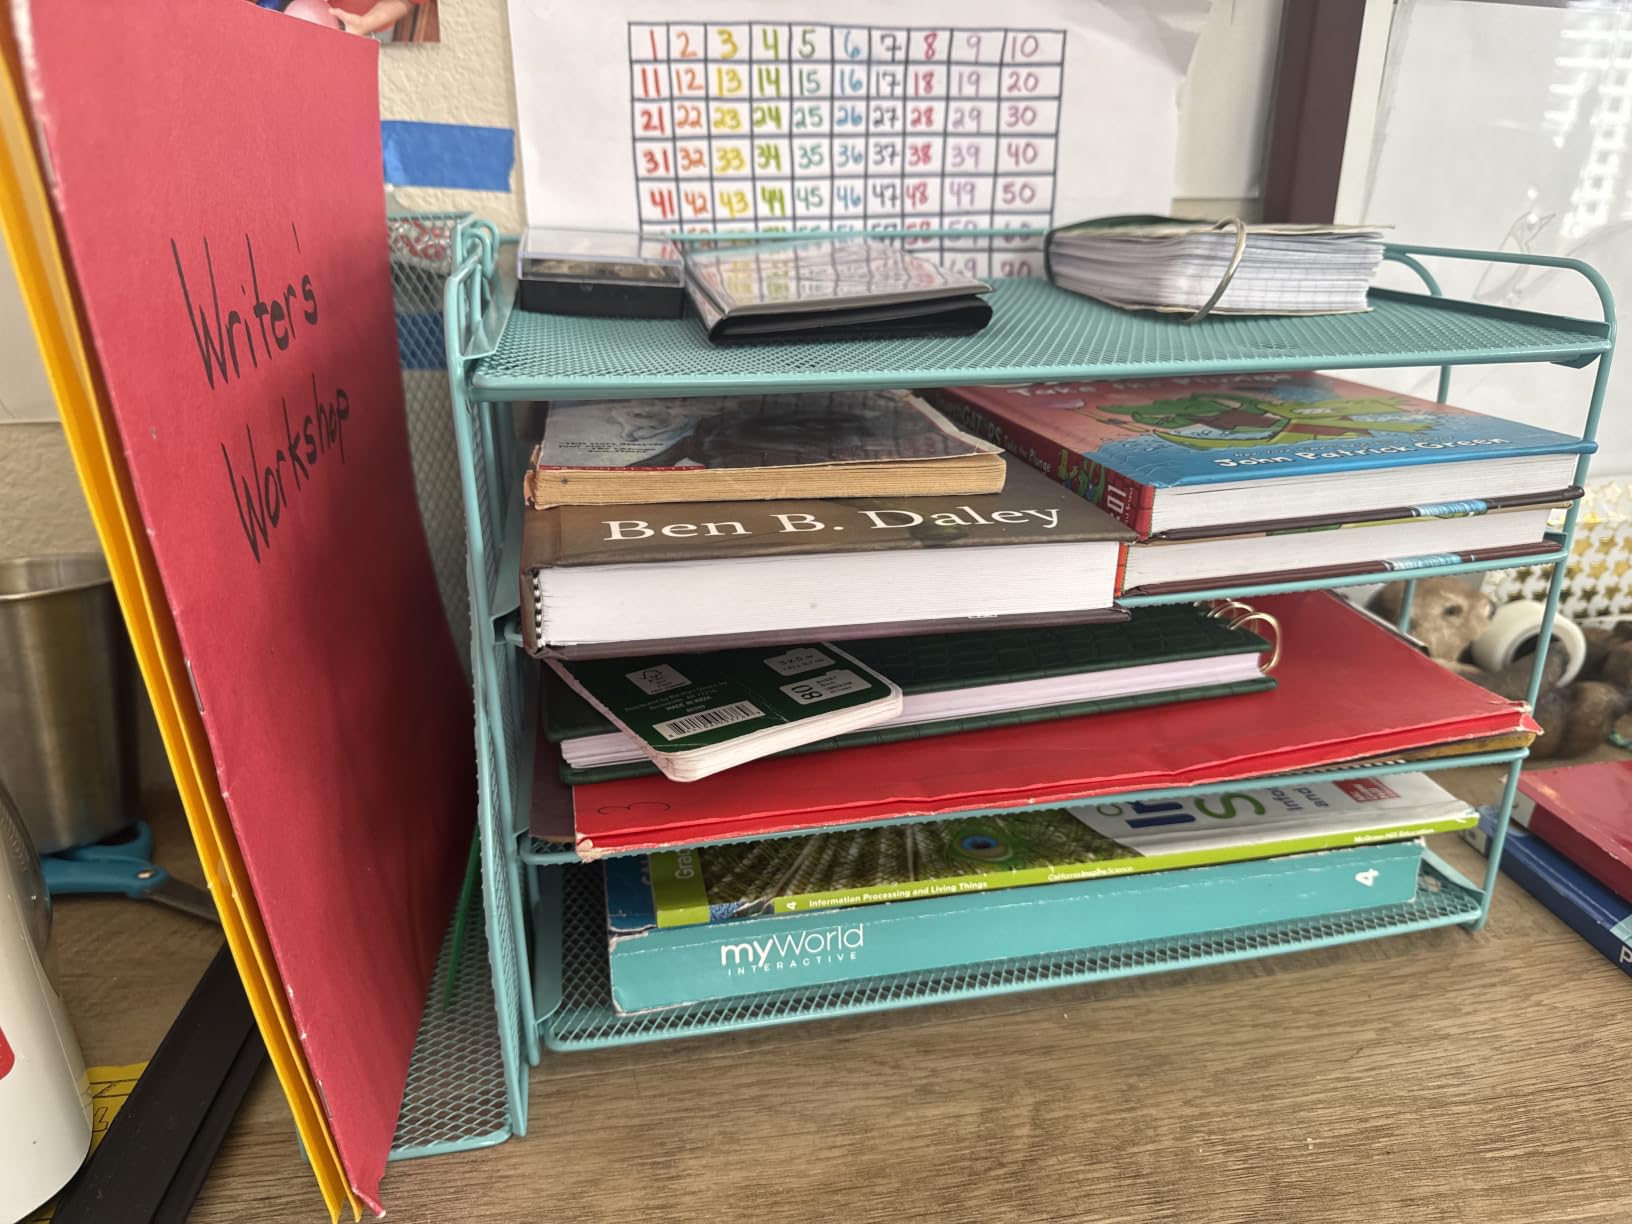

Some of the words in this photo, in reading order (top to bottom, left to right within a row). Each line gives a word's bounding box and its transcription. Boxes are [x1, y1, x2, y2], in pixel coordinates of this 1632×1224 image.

[650, 29, 658, 61] 1
[676, 31, 697, 57] 2
[717, 29, 737, 59] 3
[762, 28, 778, 60] 4
[799, 28, 816, 59] 5
[844, 31, 860, 58] 6
[880, 34, 901, 62] 7
[924, 32, 937, 60] 8
[967, 35, 981, 63] 9
[1012, 35, 1039, 61] 10
[642, 67, 660, 97] 11
[676, 67, 703, 95] 12
[717, 67, 742, 96] 13
[758, 67, 780, 96] 14
[799, 69, 820, 96] 15
[841, 69, 863, 96] 16
[876, 71, 900, 97] 17
[915, 72, 934, 96] 18
[958, 72, 980, 97] 19
[1007, 71, 1039, 92] 20
[641, 106, 665, 135] 21
[676, 104, 702, 127] 22
[713, 107, 741, 130] 23
[754, 105, 781, 129] 24
[795, 106, 823, 127] 25
[837, 107, 862, 126] 26
[873, 106, 899, 128] 27
[911, 107, 934, 126] 28
[952, 107, 982, 133] 29
[1006, 106, 1037, 127] 30
[644, 149, 669, 174] 31
[679, 146, 706, 171] 32
[716, 147, 746, 173] 33
[757, 144, 781, 171] 34
[799, 144, 824, 169] 35
[838, 145, 863, 166] 36
[873, 142, 899, 165] 37
[909, 143, 932, 166] 38
[952, 144, 980, 168] 39
[1007, 142, 1038, 166] 40
[651, 189, 675, 219] 41
[684, 190, 708, 215] 42
[719, 191, 749, 219] 43
[761, 186, 785, 217] 44
[797, 186, 823, 210] 45
[837, 186, 861, 210] 46
[872, 183, 898, 208] 47
[906, 182, 928, 208] 48
[950, 182, 975, 206] 49
[1002, 182, 1036, 204] 50
[171, 221, 318, 390] Writer's
[221, 372, 349, 564] Workshop
[1213, 456, 1293, 468] John
[1295, 443, 1414, 461] Patrick
[1414, 436, 1511, 450] Green
[601, 520, 752, 541] Ben
[768, 513, 845, 533] B.
[857, 506, 1061, 529] Daley
[791, 684, 823, 700] 80
[1295, 787, 1329, 808] and
[1355, 868, 1378, 887] 4
[786, 901, 797, 910] 4
[809, 896, 860, 908] Information
[862, 890, 910, 902] Processing
[912, 886, 929, 896] and
[931, 883, 957, 895] Living
[959, 880, 988, 891] Things
[720, 923, 864, 967] myWorld
[728, 951, 857, 976] INTERACTIVE
